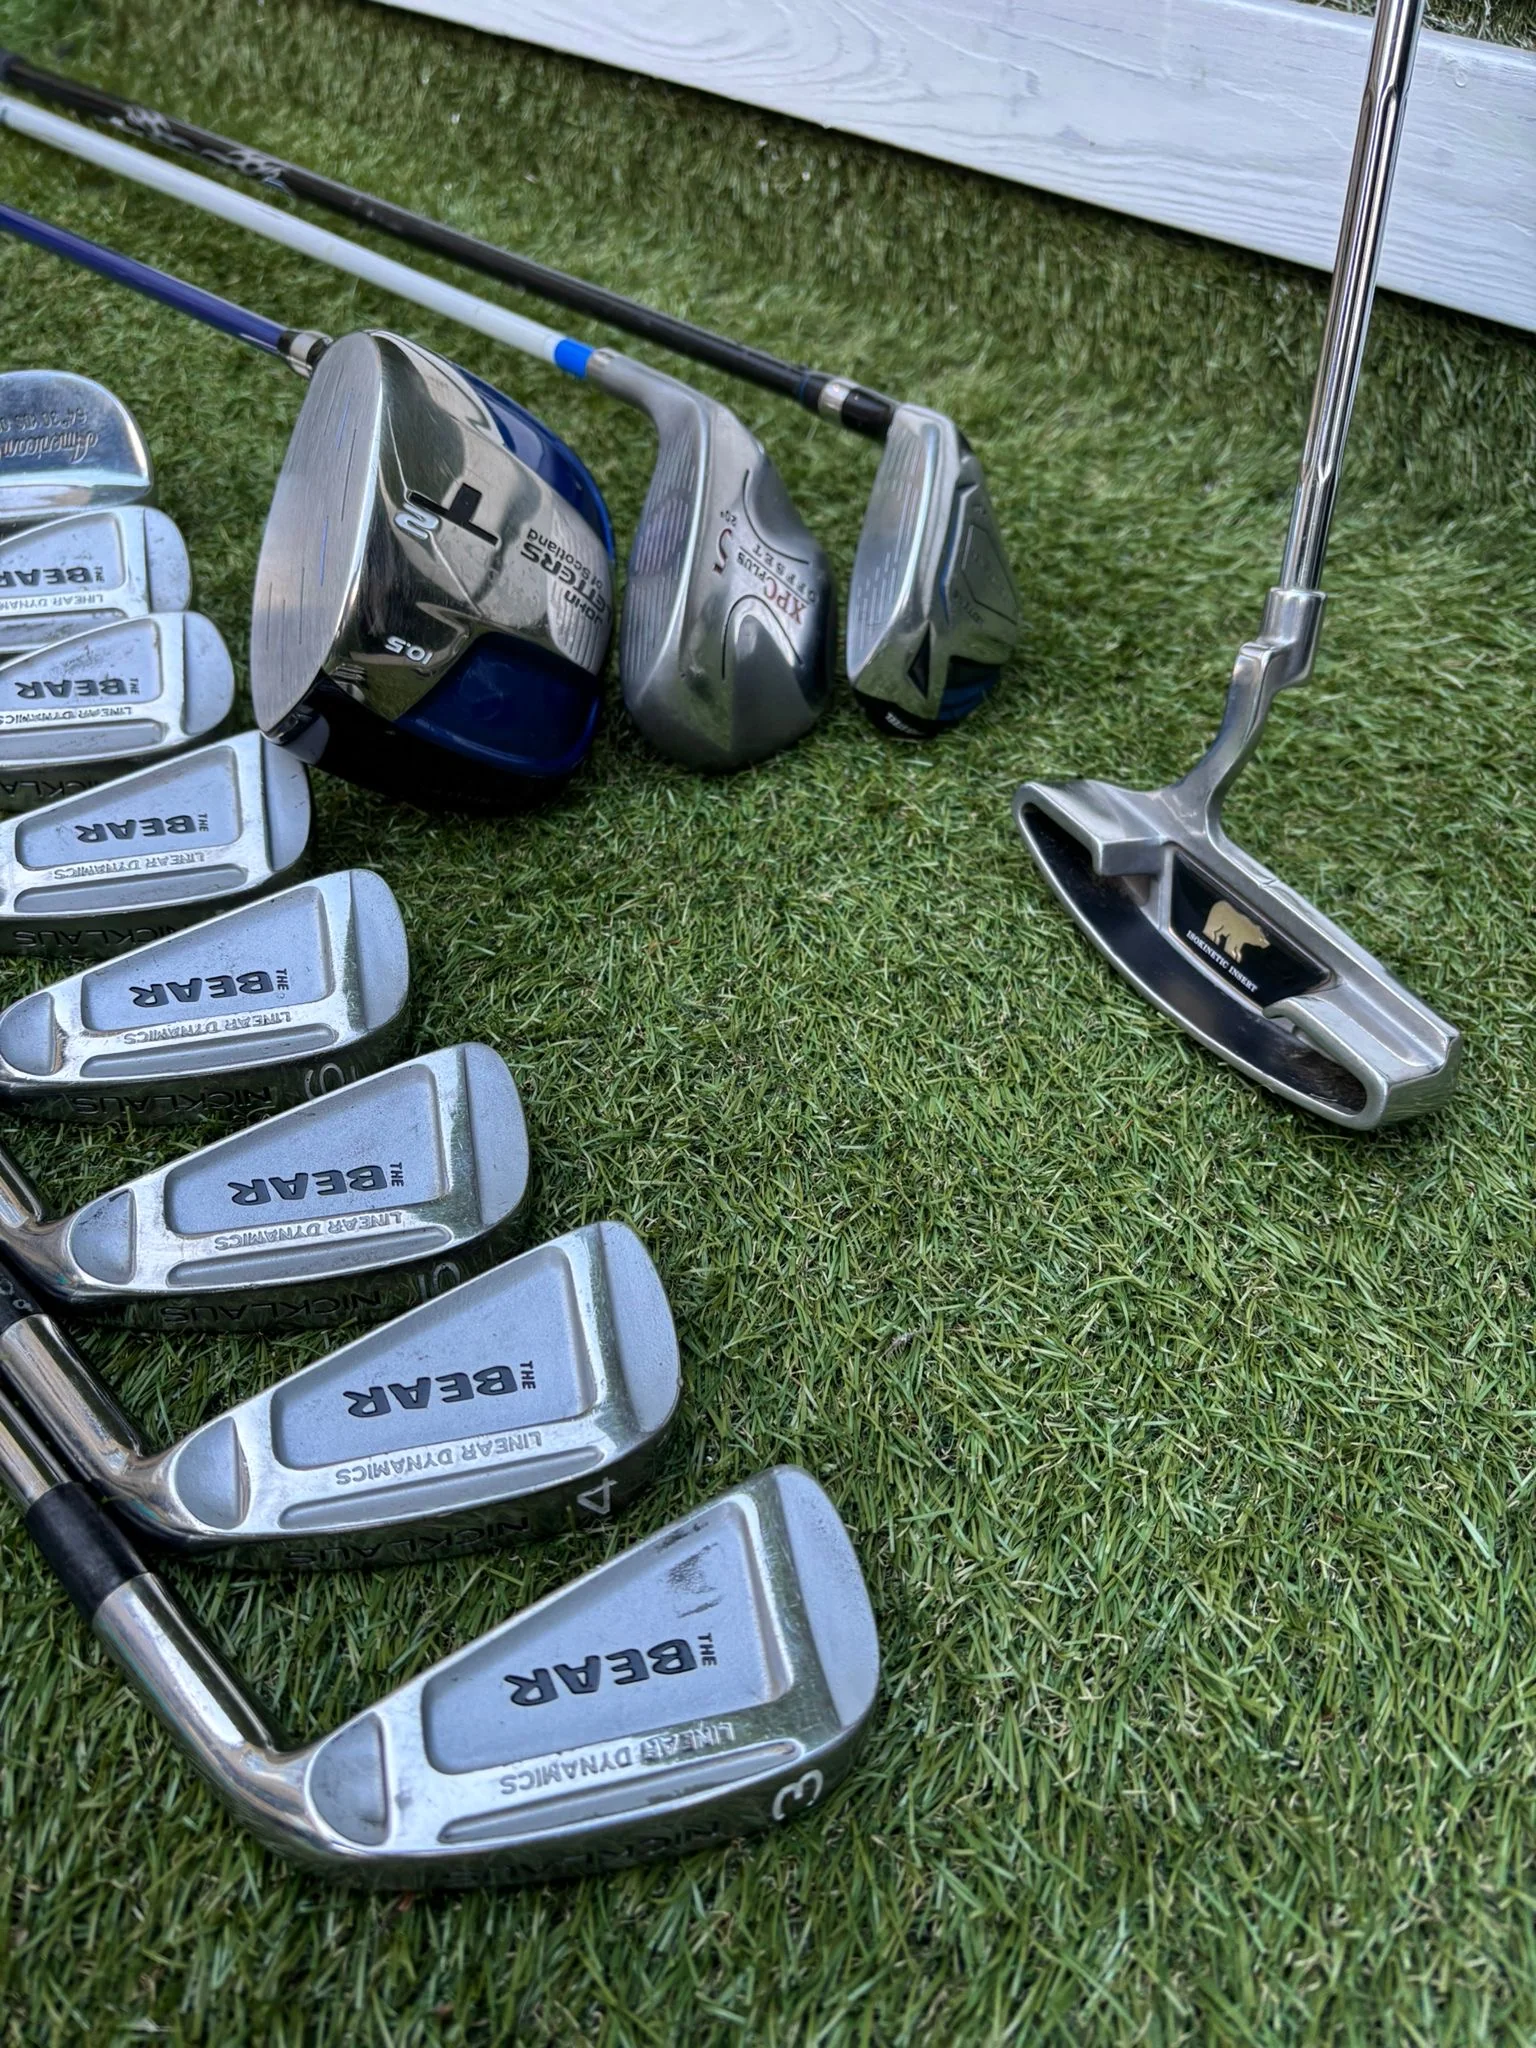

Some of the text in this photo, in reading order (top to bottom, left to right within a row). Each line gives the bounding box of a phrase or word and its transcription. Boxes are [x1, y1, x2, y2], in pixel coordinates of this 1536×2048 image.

[526, 529, 591, 579] Scotland
[385, 635, 433, 665] 10.5
[14, 678, 128, 698] BEAR
[130, 678, 139, 694] THE
[78, 707, 132, 720] LINEAR
[75, 815, 196, 843] BEAR
[198, 813, 208, 833] THE
[54, 852, 205, 880] LINEAR DYNAMICS
[1186, 930, 1258, 992] ISOKINETIC INSERT
[129, 971, 273, 1008] BEAR
[274, 968, 289, 991] THE
[124, 1011, 292, 1045] LINEAR DYNAMICS
[74, 1087, 272, 1114] NICKLAUS
[227, 1165, 388, 1206] BEAR
[390, 1162, 404, 1187] THE
[214, 1211, 402, 1251] LINEAR DYNAMICS
[161, 1289, 381, 1324] NICKLAUS
[342, 1365, 519, 1419] BEAR
[520, 1360, 537, 1390] THE
[335, 1430, 544, 1486] LINEAR DYNAMICS
[577, 1477, 618, 1515] 4
[697, 1633, 717, 1667] THE
[504, 1639, 698, 1706] BEAR
[499, 1721, 735, 1795] LINEAR DYNAMICS
[771, 1768, 823, 1822] 3
